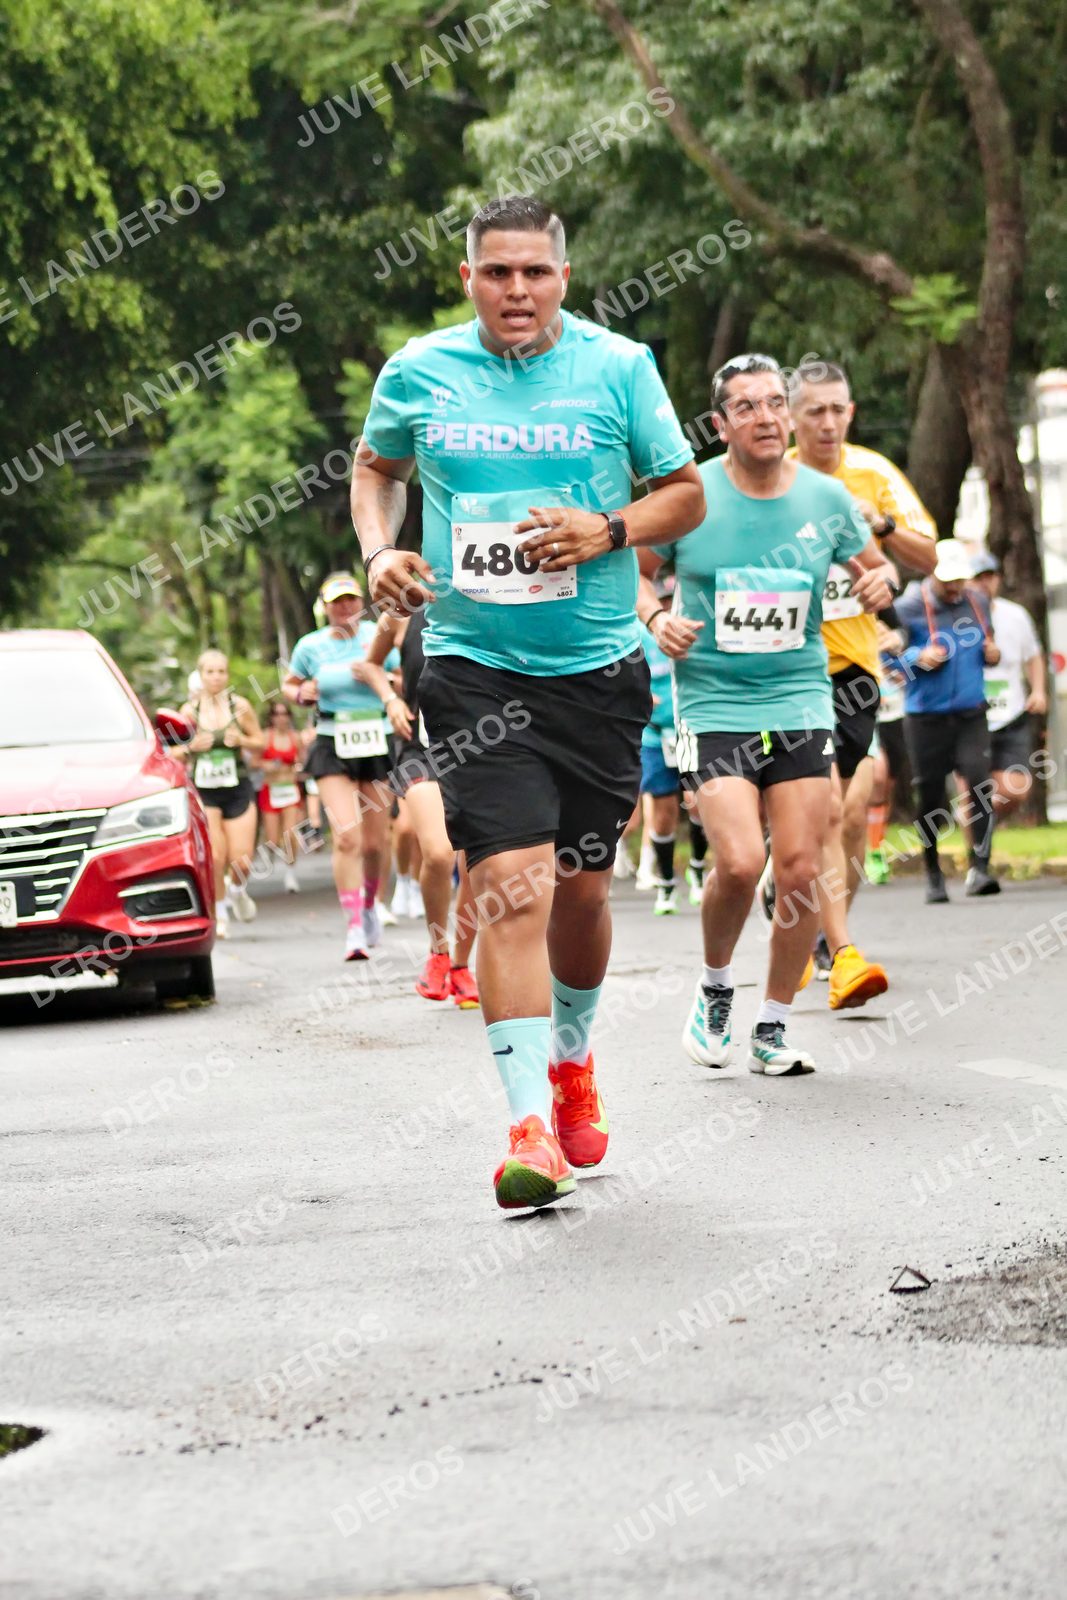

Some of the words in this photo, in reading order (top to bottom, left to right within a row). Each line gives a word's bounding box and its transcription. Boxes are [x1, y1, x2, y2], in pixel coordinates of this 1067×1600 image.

[550, 400, 599, 409] BROOKS
[426, 422, 595, 453] PERDURA
[723, 607, 799, 631] 4441
[340, 730, 380, 746] 1031
